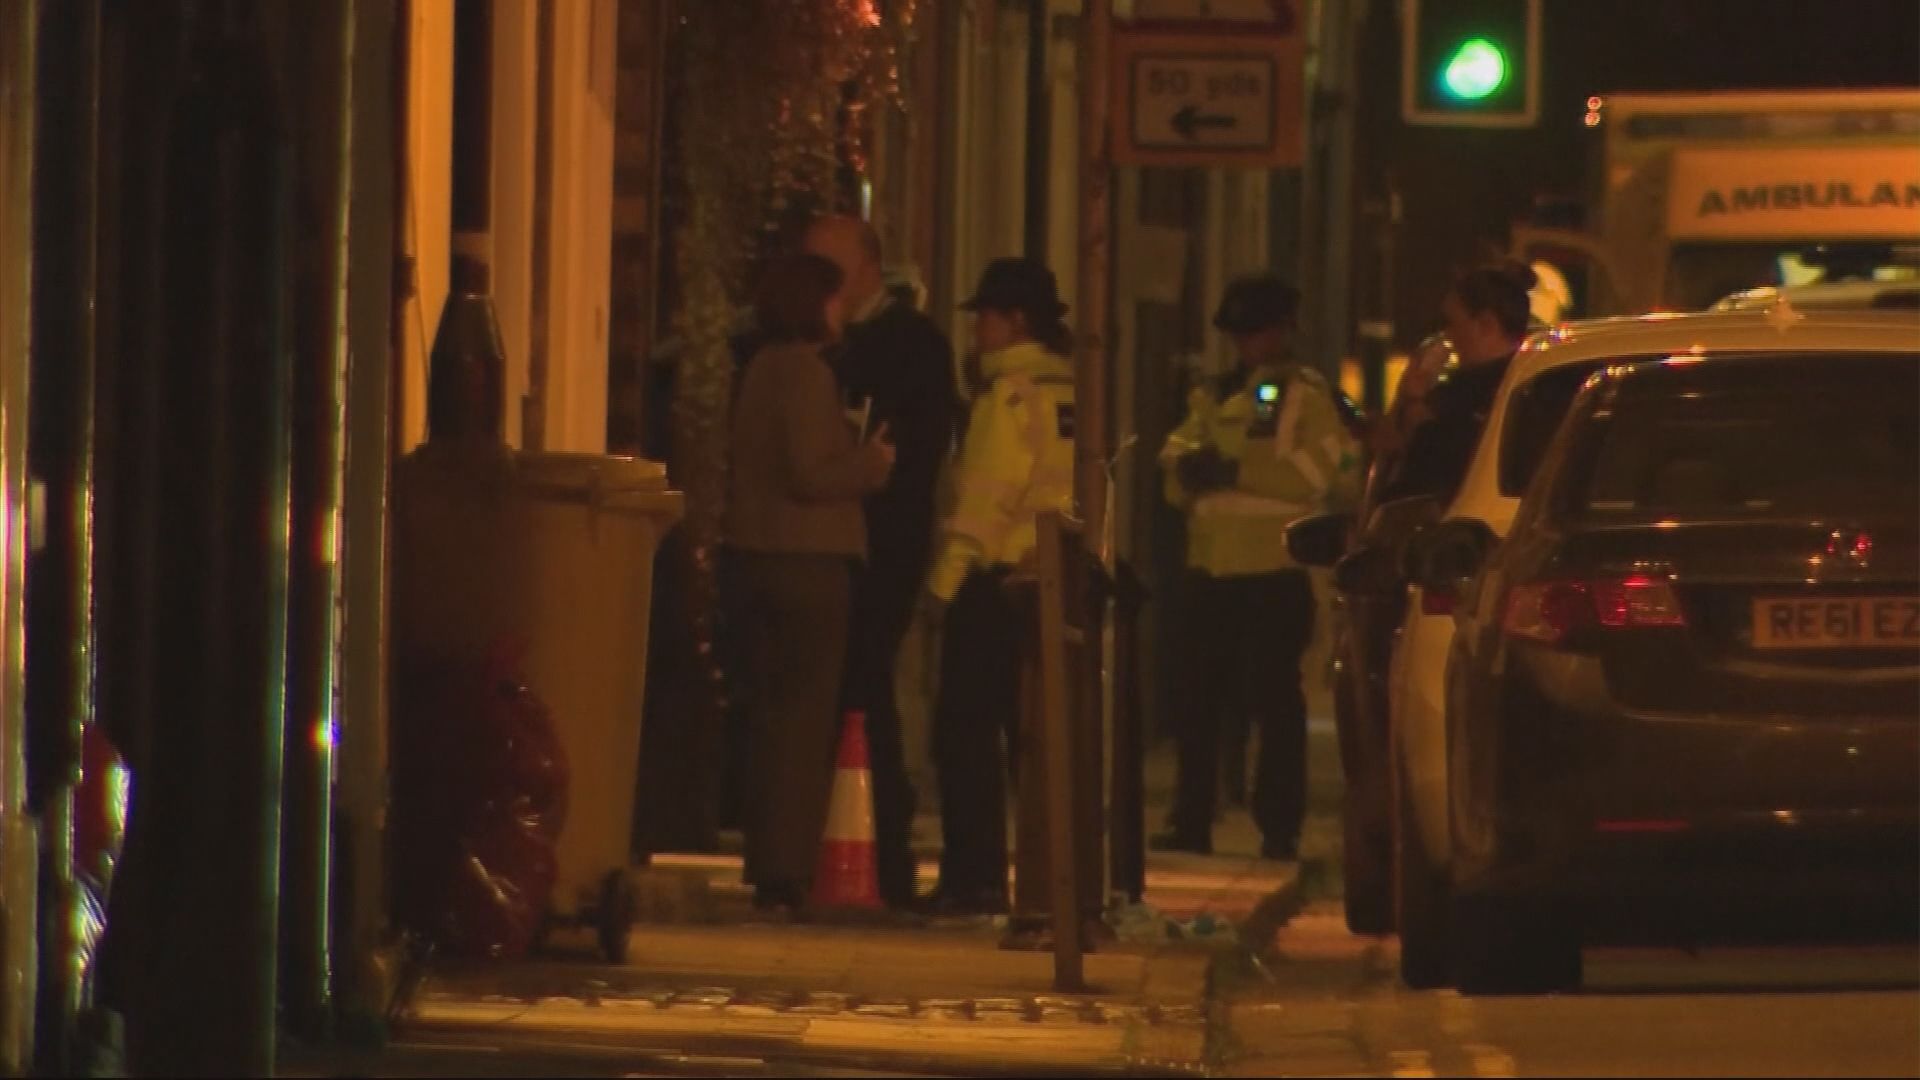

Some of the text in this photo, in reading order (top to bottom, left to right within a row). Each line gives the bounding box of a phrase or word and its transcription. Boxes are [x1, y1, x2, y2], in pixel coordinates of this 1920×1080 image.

[1148, 68, 1261, 102] 50 yds
[1771, 602, 1859, 639] RE61
